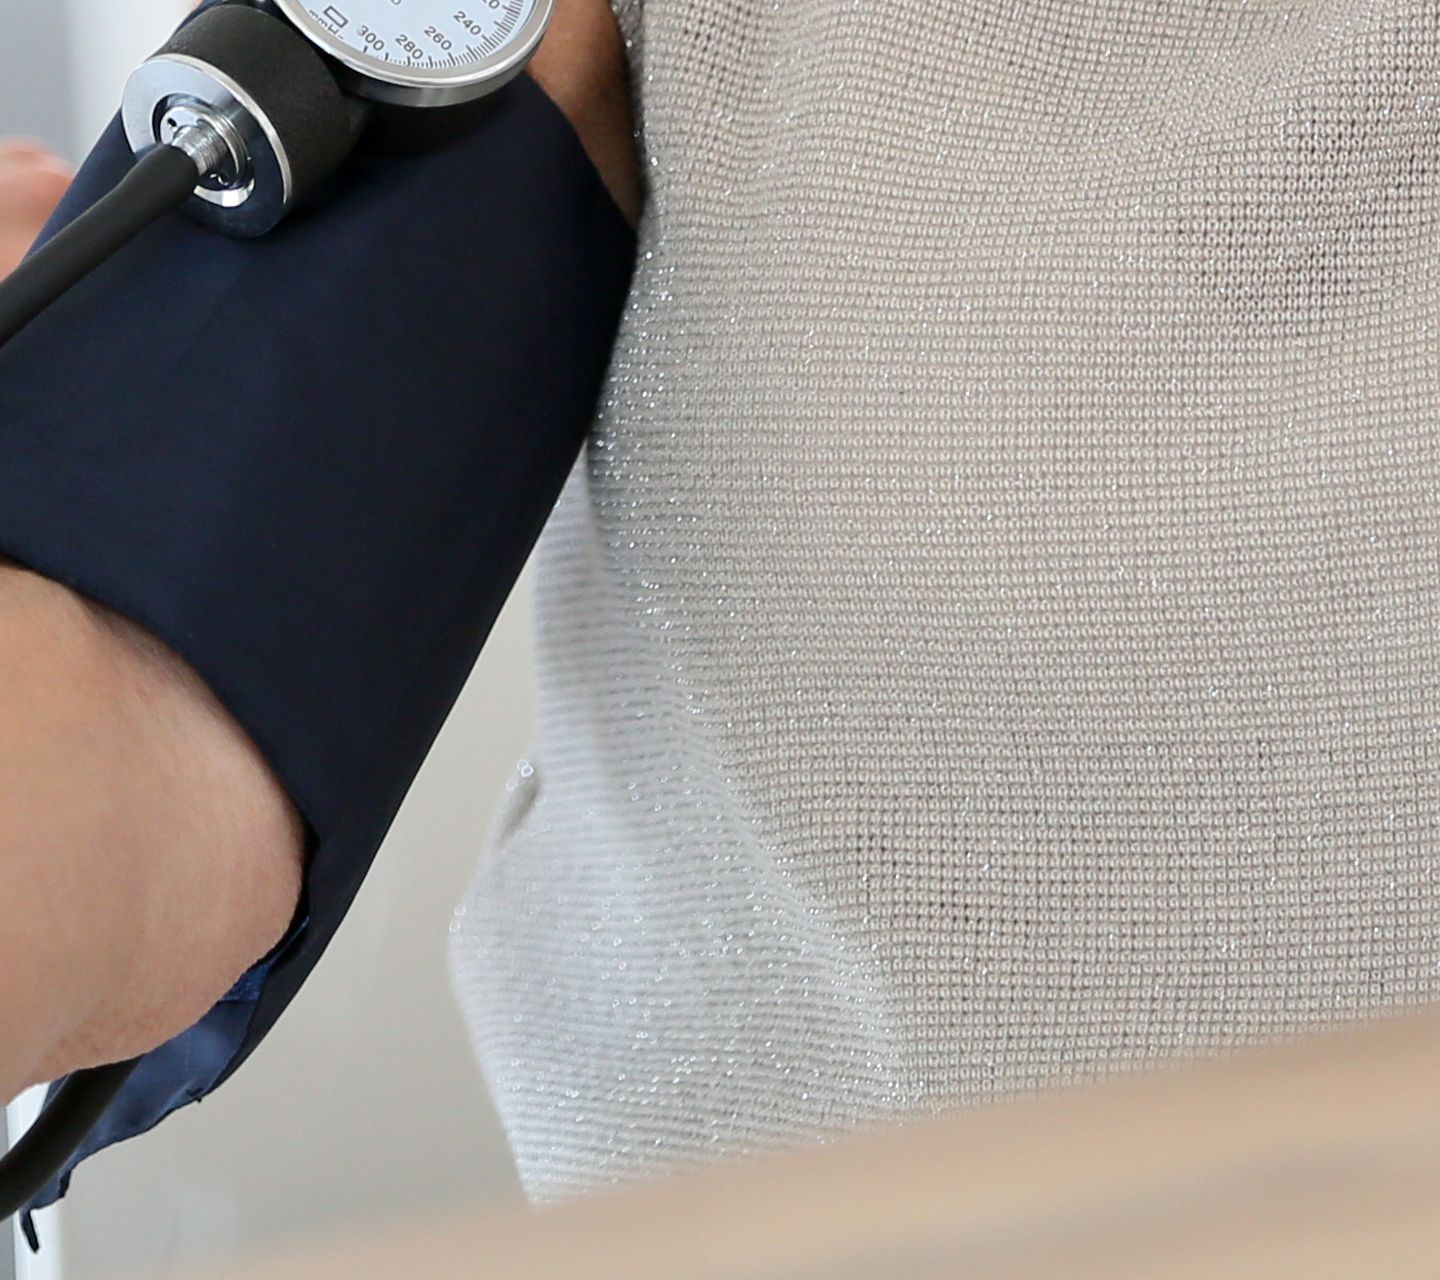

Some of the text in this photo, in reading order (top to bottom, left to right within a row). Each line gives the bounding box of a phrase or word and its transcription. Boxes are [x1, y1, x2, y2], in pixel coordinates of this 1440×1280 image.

[309, 9, 344, 40] mmH
[453, 10, 481, 36] 240
[357, 24, 385, 51] 300
[395, 33, 424, 60] 280
[423, 25, 452, 51] 260
